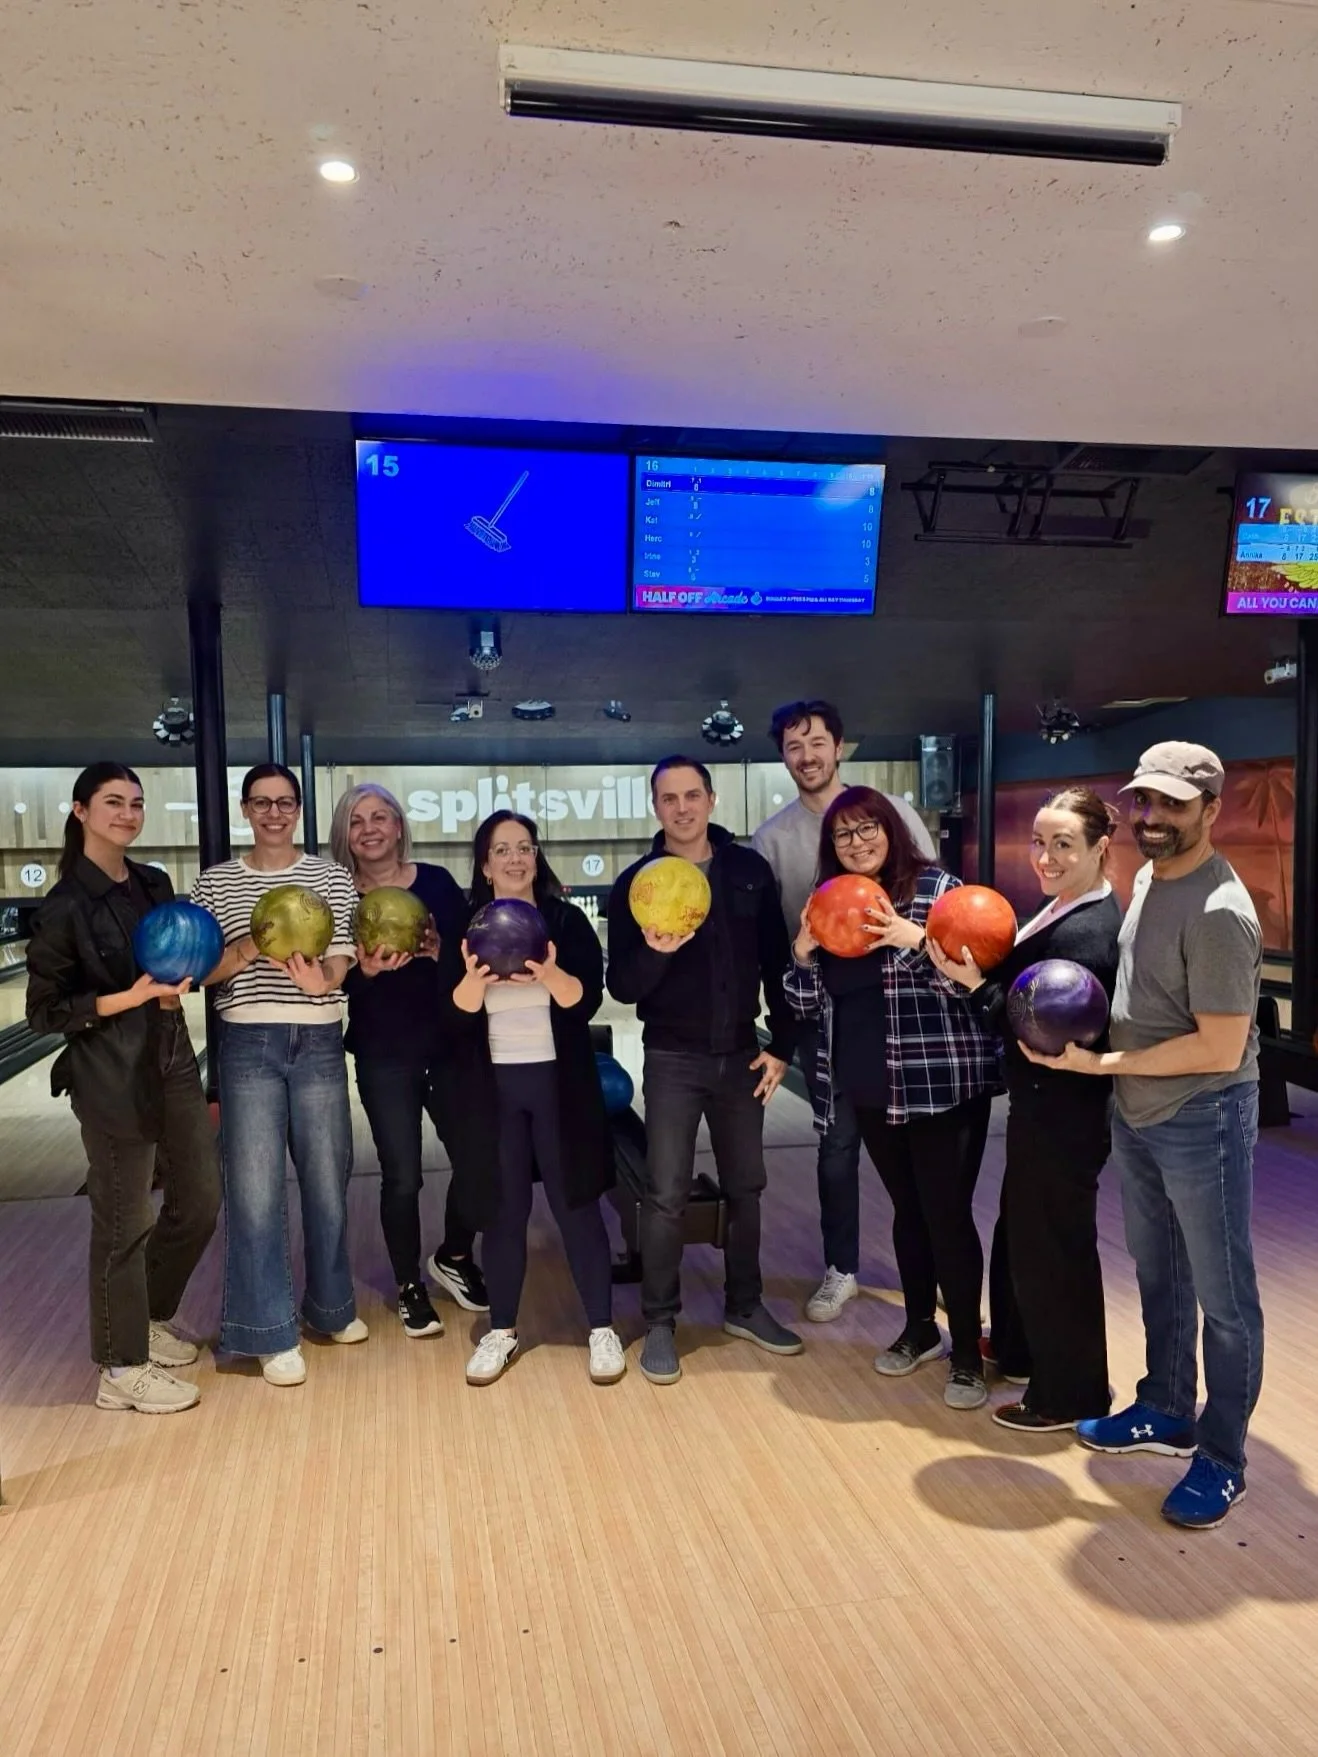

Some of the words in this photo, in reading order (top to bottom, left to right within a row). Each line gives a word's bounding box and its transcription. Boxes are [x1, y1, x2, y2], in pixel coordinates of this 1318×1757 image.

[365, 454, 400, 477] 15
[646, 460, 659, 472] 16
[1246, 497, 1271, 519] 17
[862, 522, 873, 531] 10
[861, 539, 872, 549] 10
[865, 557, 870, 566] 3
[863, 574, 869, 583] 5
[642, 590, 677, 604] HALF
[677, 591, 704, 604] OFF
[1237, 597, 1258, 608] ALL
[1261, 597, 1288, 608] YOU
[1289, 597, 1317, 608] CAN
[406, 774, 657, 834] splitsvill
[585, 859, 600, 872] 17
[24, 869, 42, 881] 12
